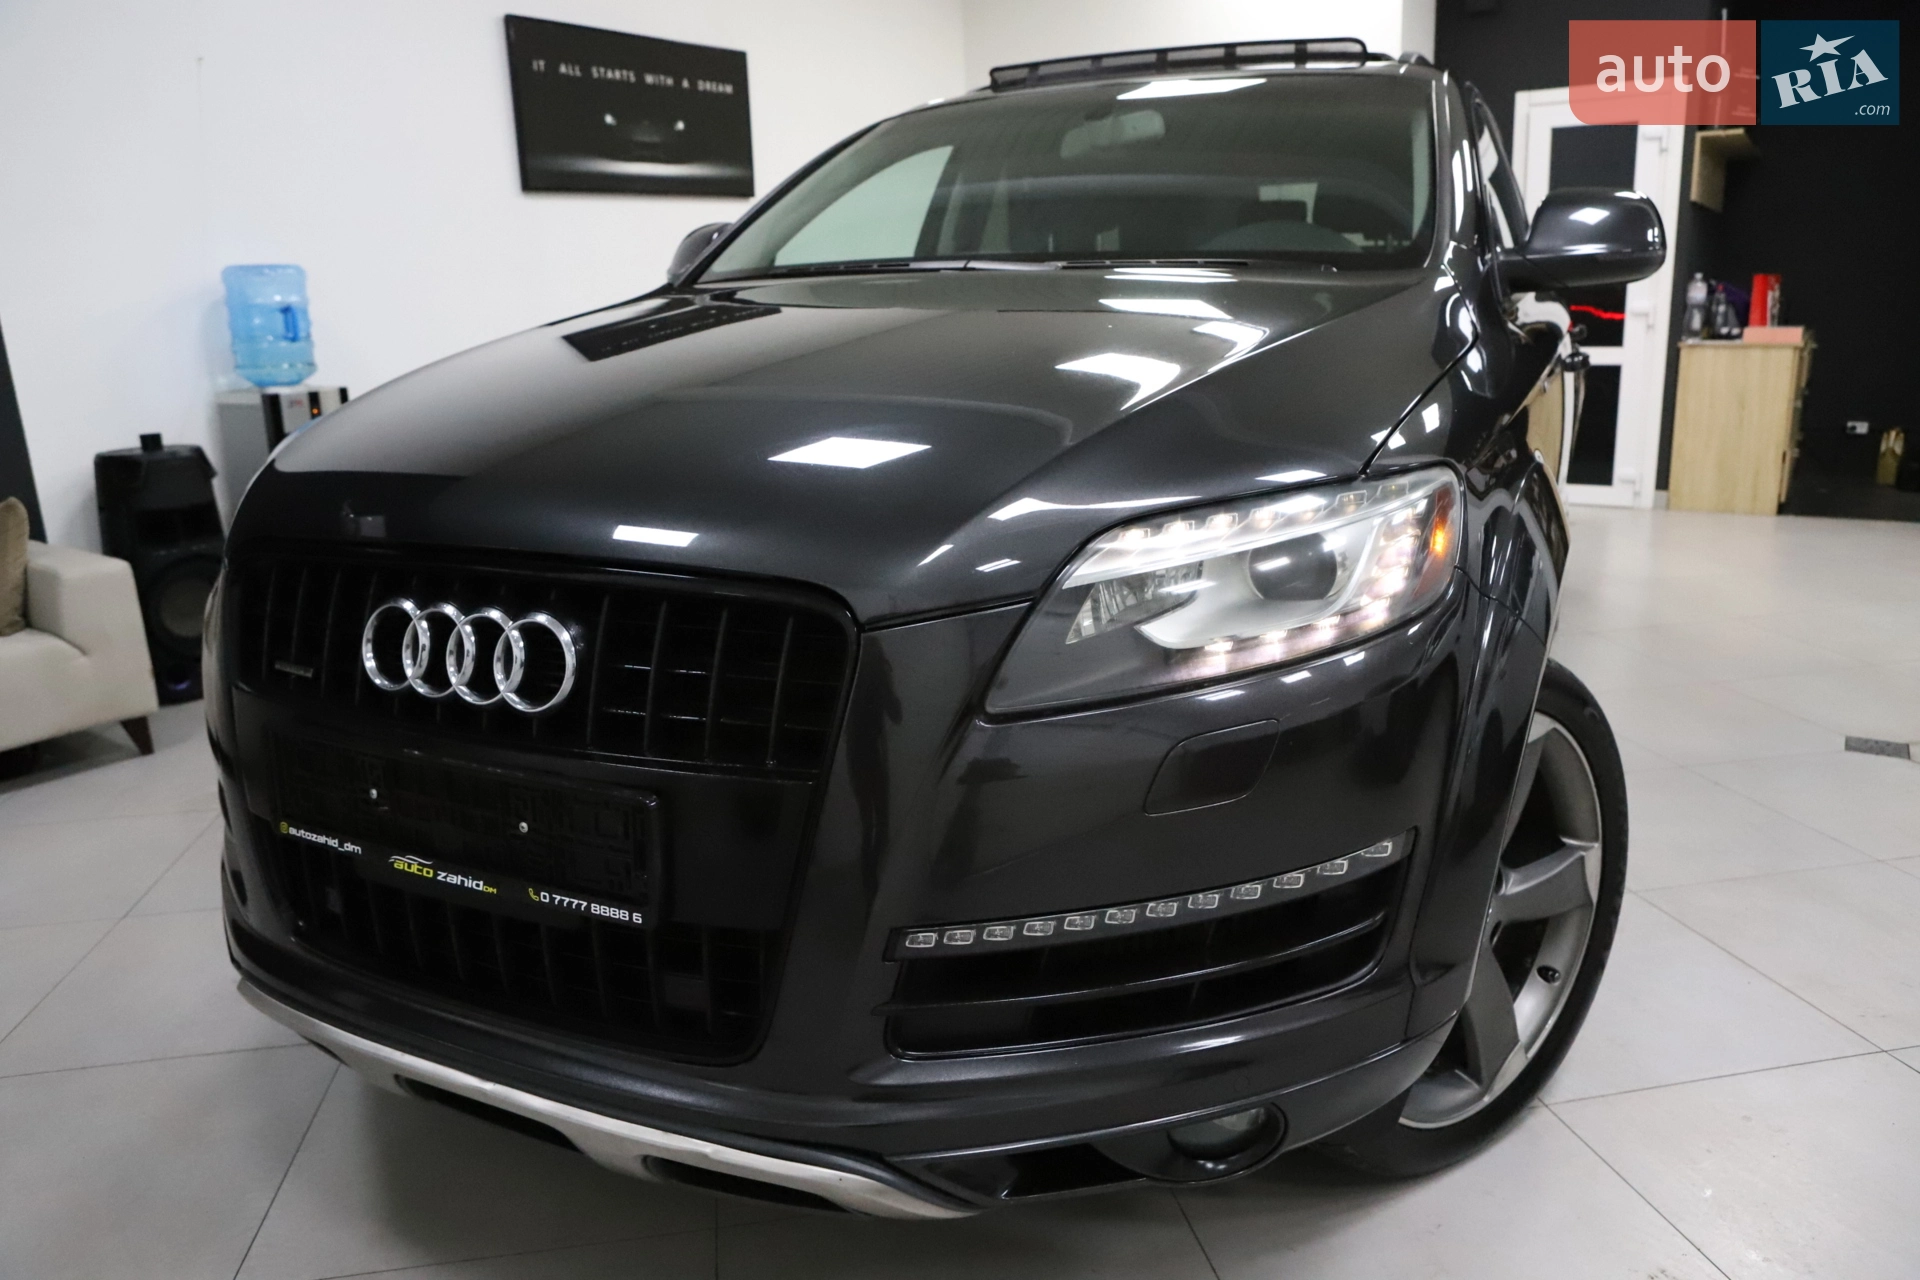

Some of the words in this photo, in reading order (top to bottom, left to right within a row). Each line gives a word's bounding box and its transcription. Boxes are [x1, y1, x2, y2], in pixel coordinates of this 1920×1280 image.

[532, 59, 546, 72] IT
[559, 62, 582, 77] ALL
[591, 66, 636, 84] STARTS
[644, 72, 674, 88] WITH
[682, 78, 690, 89] A
[697, 79, 734, 95] DREAM
[393, 860, 434, 878] auto
[540, 891, 550, 903] 0
[552, 894, 588, 911] 7777
[590, 903, 630, 921] 8888
[632, 912, 643, 924] 6
